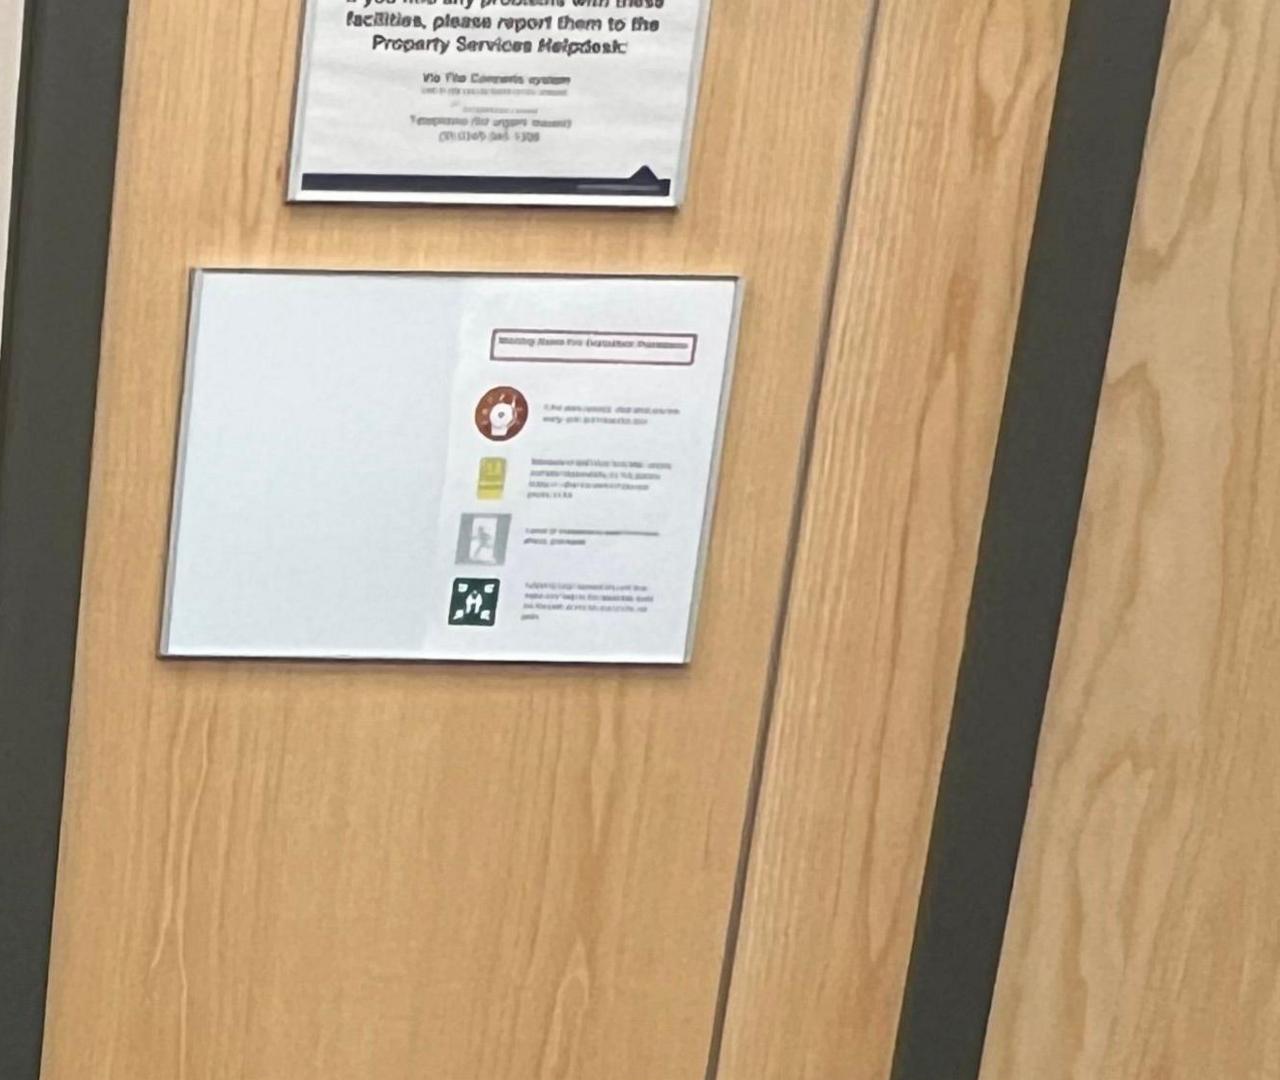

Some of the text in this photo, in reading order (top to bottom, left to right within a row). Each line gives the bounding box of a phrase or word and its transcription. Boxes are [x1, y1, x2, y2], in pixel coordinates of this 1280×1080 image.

[346, 11, 660, 32] facilities, please report them to the
[372, 34, 450, 55] Property
[456, 36, 532, 53] Services
